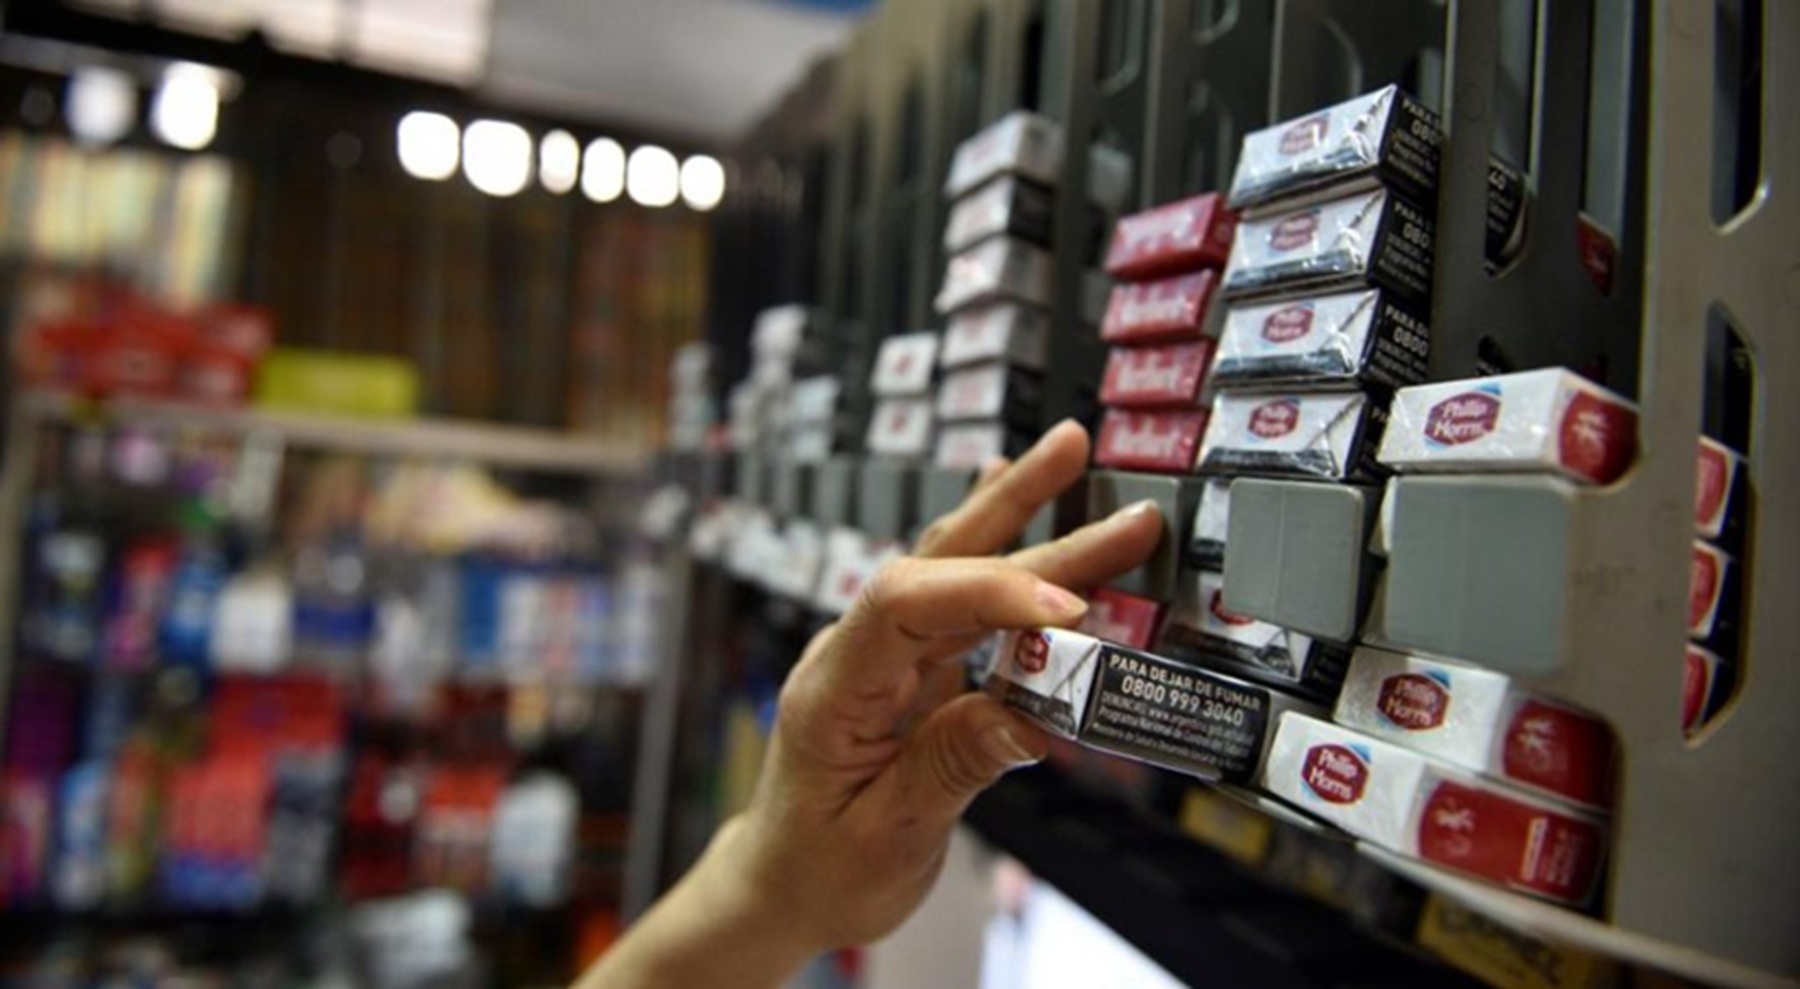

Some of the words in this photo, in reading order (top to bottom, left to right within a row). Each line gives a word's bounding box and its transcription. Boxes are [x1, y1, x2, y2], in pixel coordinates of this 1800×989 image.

[1385, 304, 1415, 330] PARA
[1393, 327, 1429, 358] 0800
[1109, 653, 1148, 677] PARA
[1150, 665, 1193, 690] DEJAR
[1195, 681, 1213, 697] DE
[1215, 686, 1261, 711] FUMAR
[1121, 675, 1165, 704] 0800
[1169, 689, 1200, 713] 999
[1203, 700, 1244, 727] 3040
[1318, 748, 1358, 779] Philip
[1309, 766, 1352, 800] Morris
